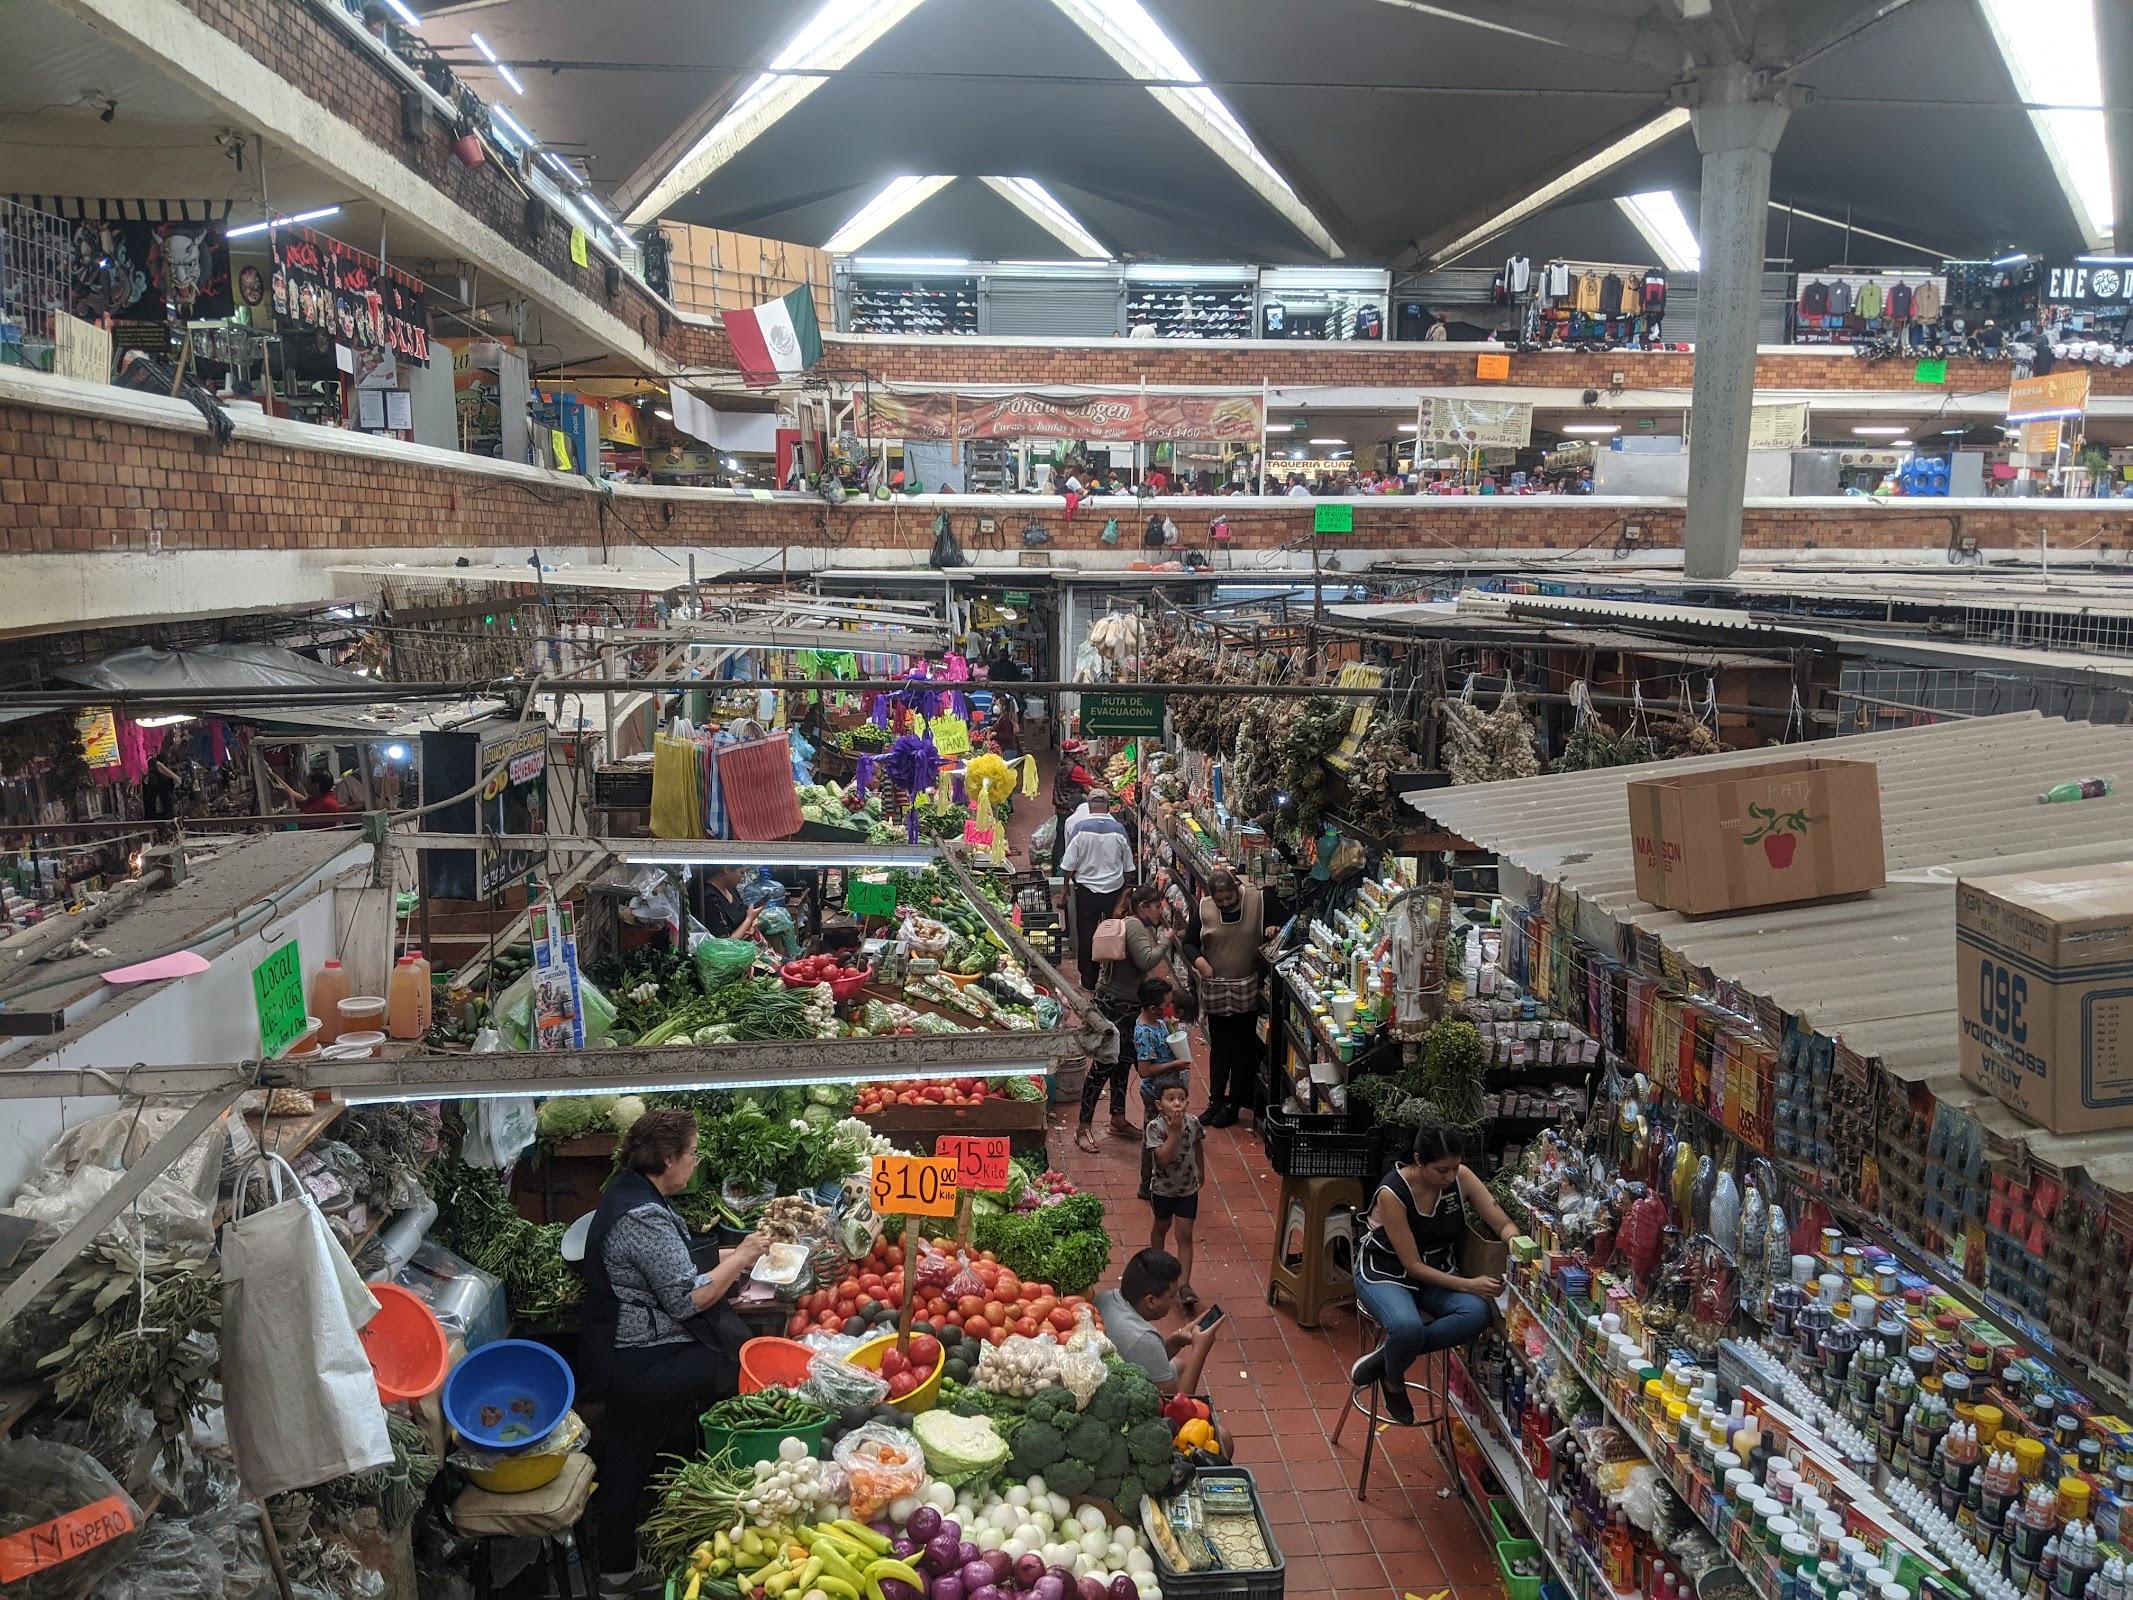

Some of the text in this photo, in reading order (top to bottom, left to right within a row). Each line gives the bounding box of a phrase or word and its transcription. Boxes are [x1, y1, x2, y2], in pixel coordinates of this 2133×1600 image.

[2049, 268, 2088, 298] ENE
[1090, 706, 1153, 717] EVACUACIÓN
[1101, 697, 1143, 706] RUTA DE
[483, 739, 513, 768] AGUACAT
[1636, 836, 1681, 863] MASON
[259, 944, 293, 999] Local
[1980, 959, 2028, 1044] 360
[1962, 1016, 2047, 1078] ESCONDIDA
[1981, 1052, 2023, 1090] AGUA
[1976, 1071, 2030, 1110] AVILA
[874, 1159, 938, 1206] $10
[1851, 1526, 1881, 1558] Hier
